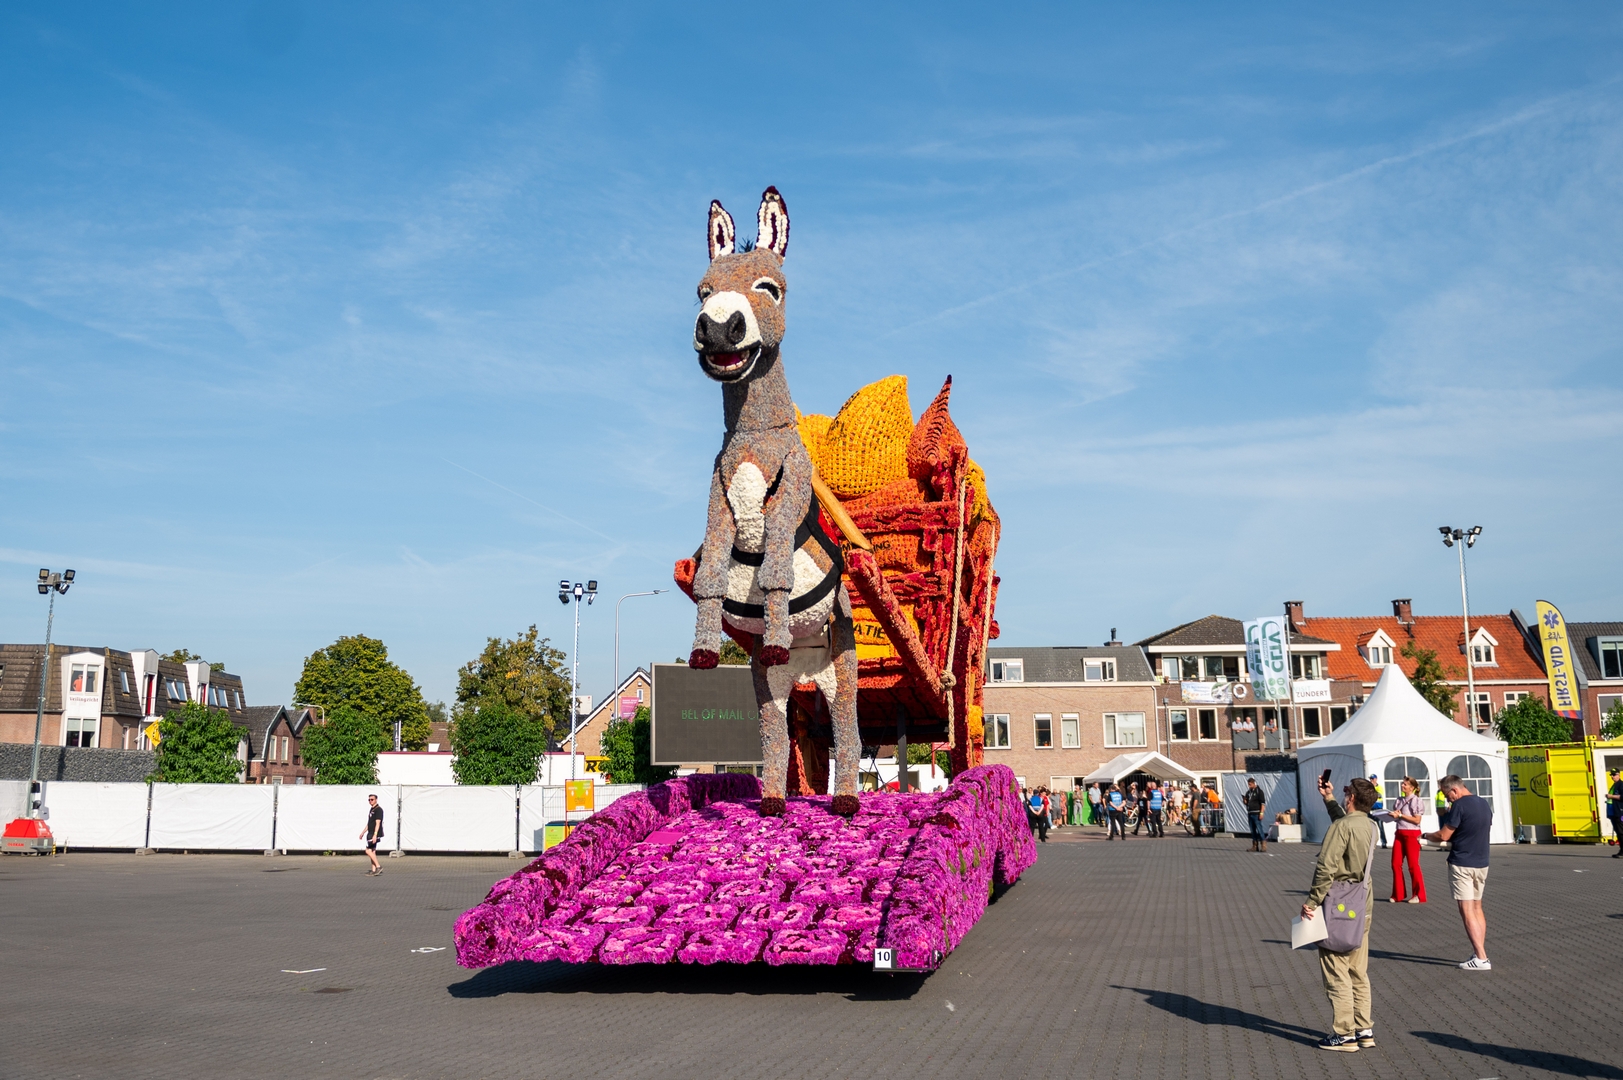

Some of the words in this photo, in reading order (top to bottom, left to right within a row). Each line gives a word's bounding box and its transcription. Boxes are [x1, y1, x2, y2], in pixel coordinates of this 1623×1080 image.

[1295, 690, 1328, 698] ZUNDERT
[681, 709, 699, 720] BEL
[701, 708, 716, 720] OF
[719, 708, 745, 720] MAIL
[877, 951, 891, 962] 10
